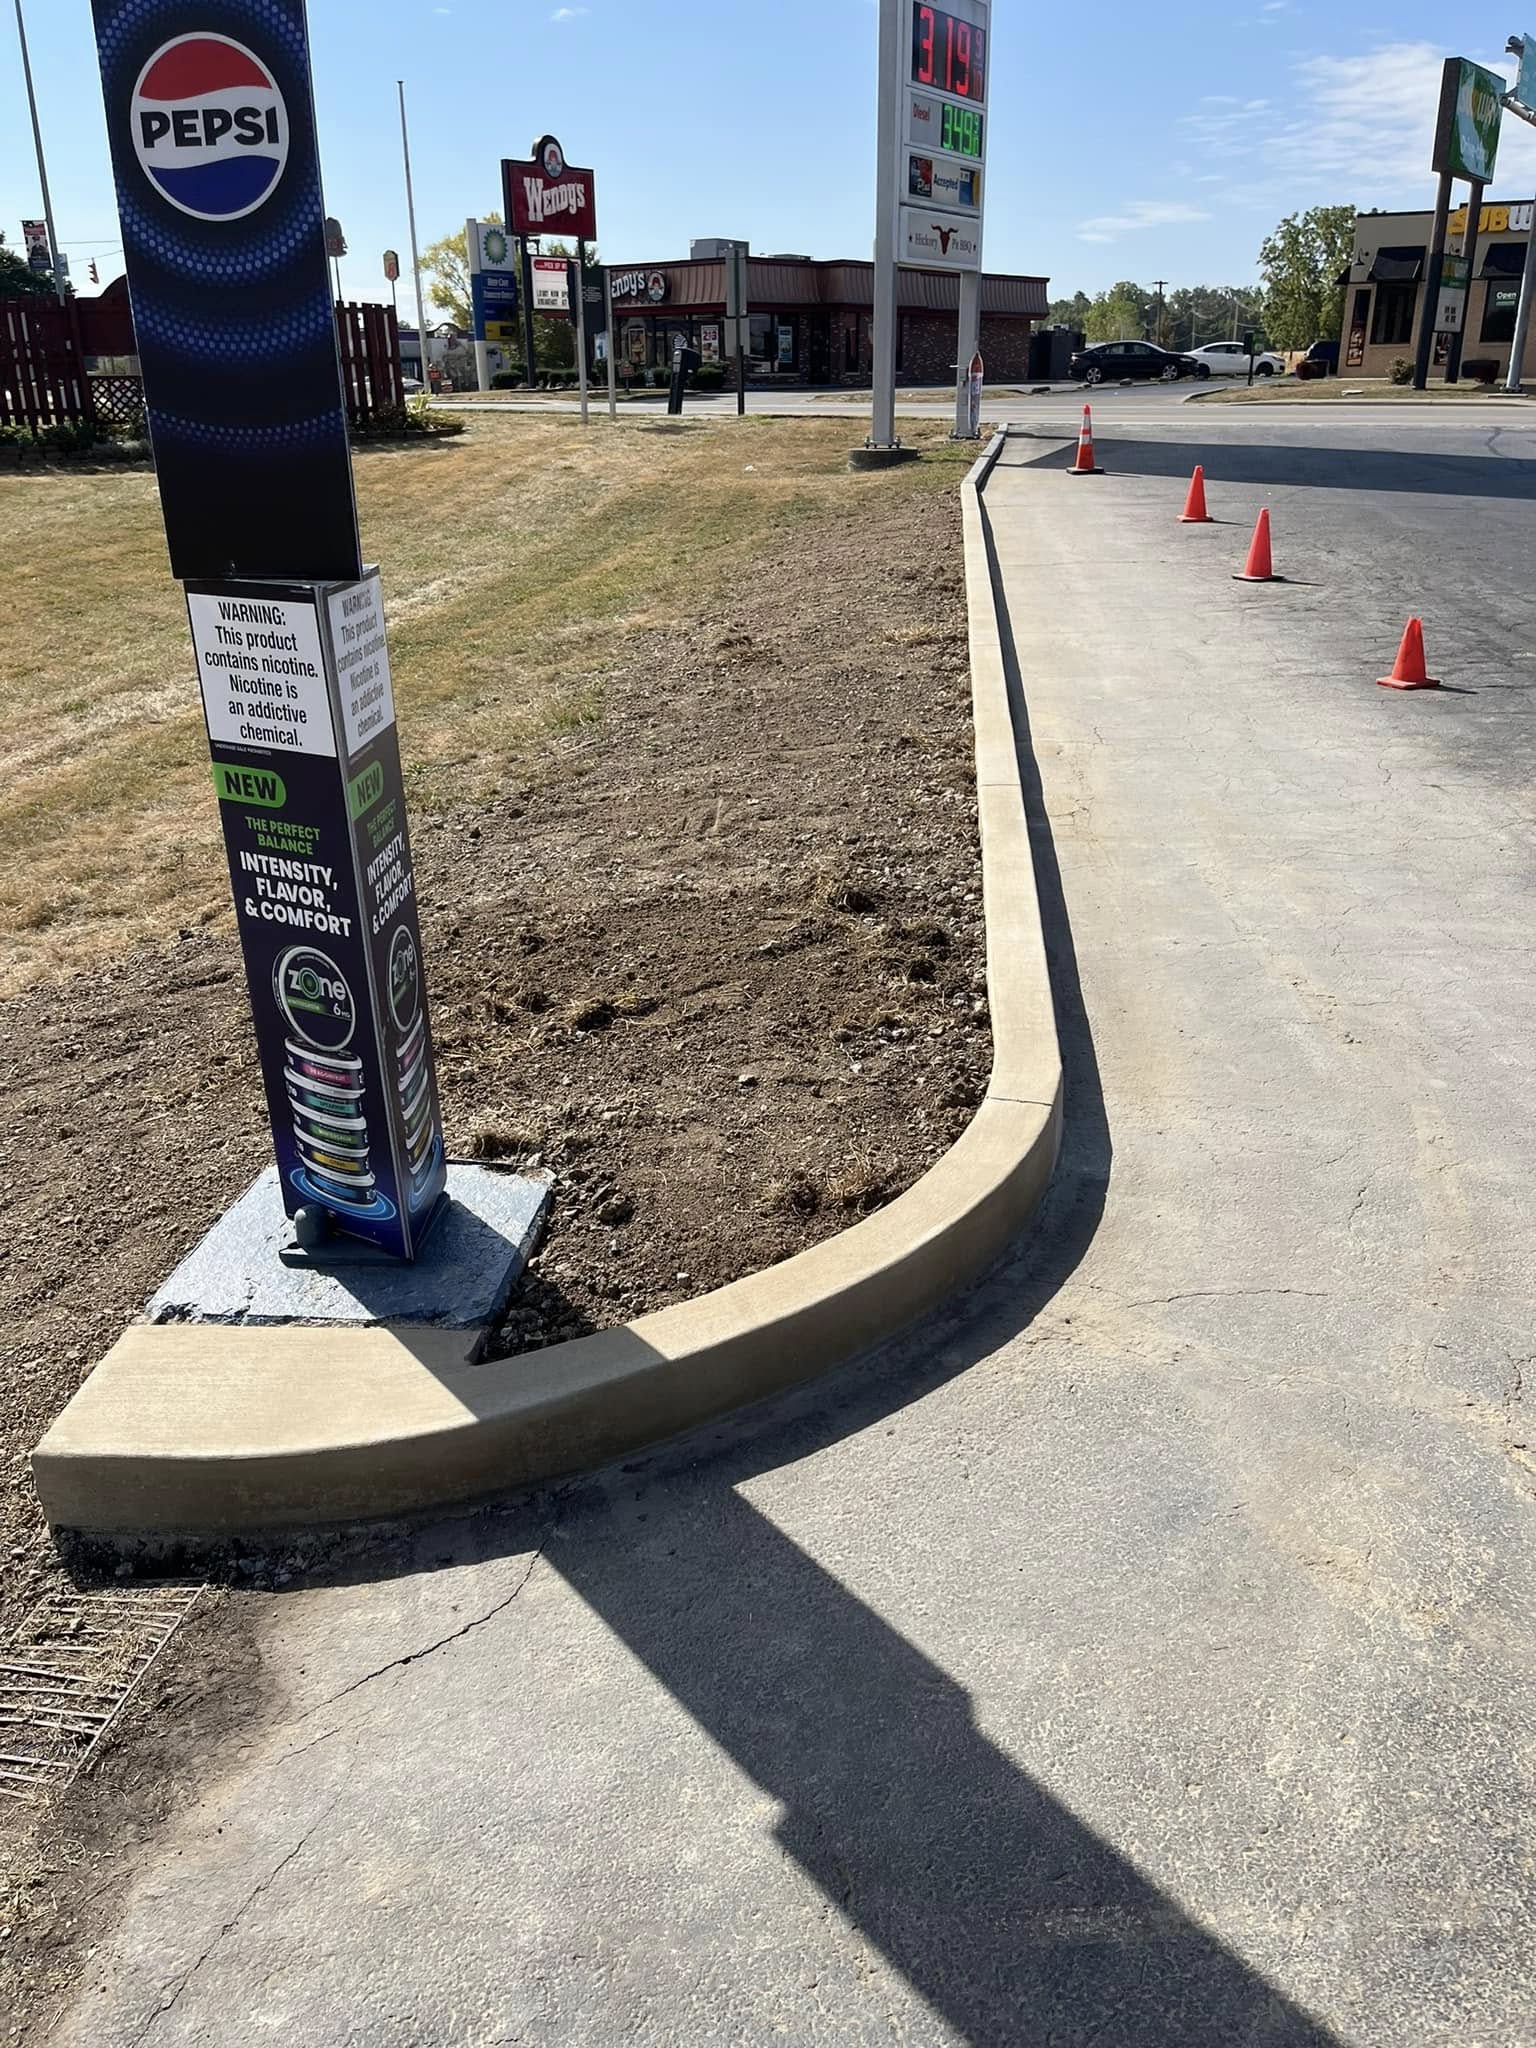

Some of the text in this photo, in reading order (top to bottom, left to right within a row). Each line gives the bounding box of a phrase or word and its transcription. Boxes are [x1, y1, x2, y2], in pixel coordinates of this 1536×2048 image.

[918, 6, 970, 95] 3.19
[140, 106, 280, 149] PEPSI
[523, 176, 586, 222] Wendy's
[218, 601, 286, 626] WARNING:
[340, 612, 377, 645] This product
[214, 625, 298, 651] This product
[204, 651, 319, 678] contains nicotine.
[229, 674, 298, 700] Nicotine is
[228, 700, 308, 724] an addictive
[239, 722, 303, 747] chemical.
[224, 771, 277, 801] NEW
[356, 767, 380, 808] NEW
[244, 816, 321, 841] THE PERFECT
[257, 833, 313, 856] BALANCE
[239, 850, 338, 891] INTENSITY,
[367, 831, 406, 886] INTENSITY,
[255, 876, 331, 912] FLAVOR,
[375, 860, 405, 905] FLAVOR,
[244, 897, 351, 937] & COMFORT
[372, 872, 413, 935] & COMFORT
[287, 967, 347, 1001] zone
[332, 1002, 342, 1016] 6
